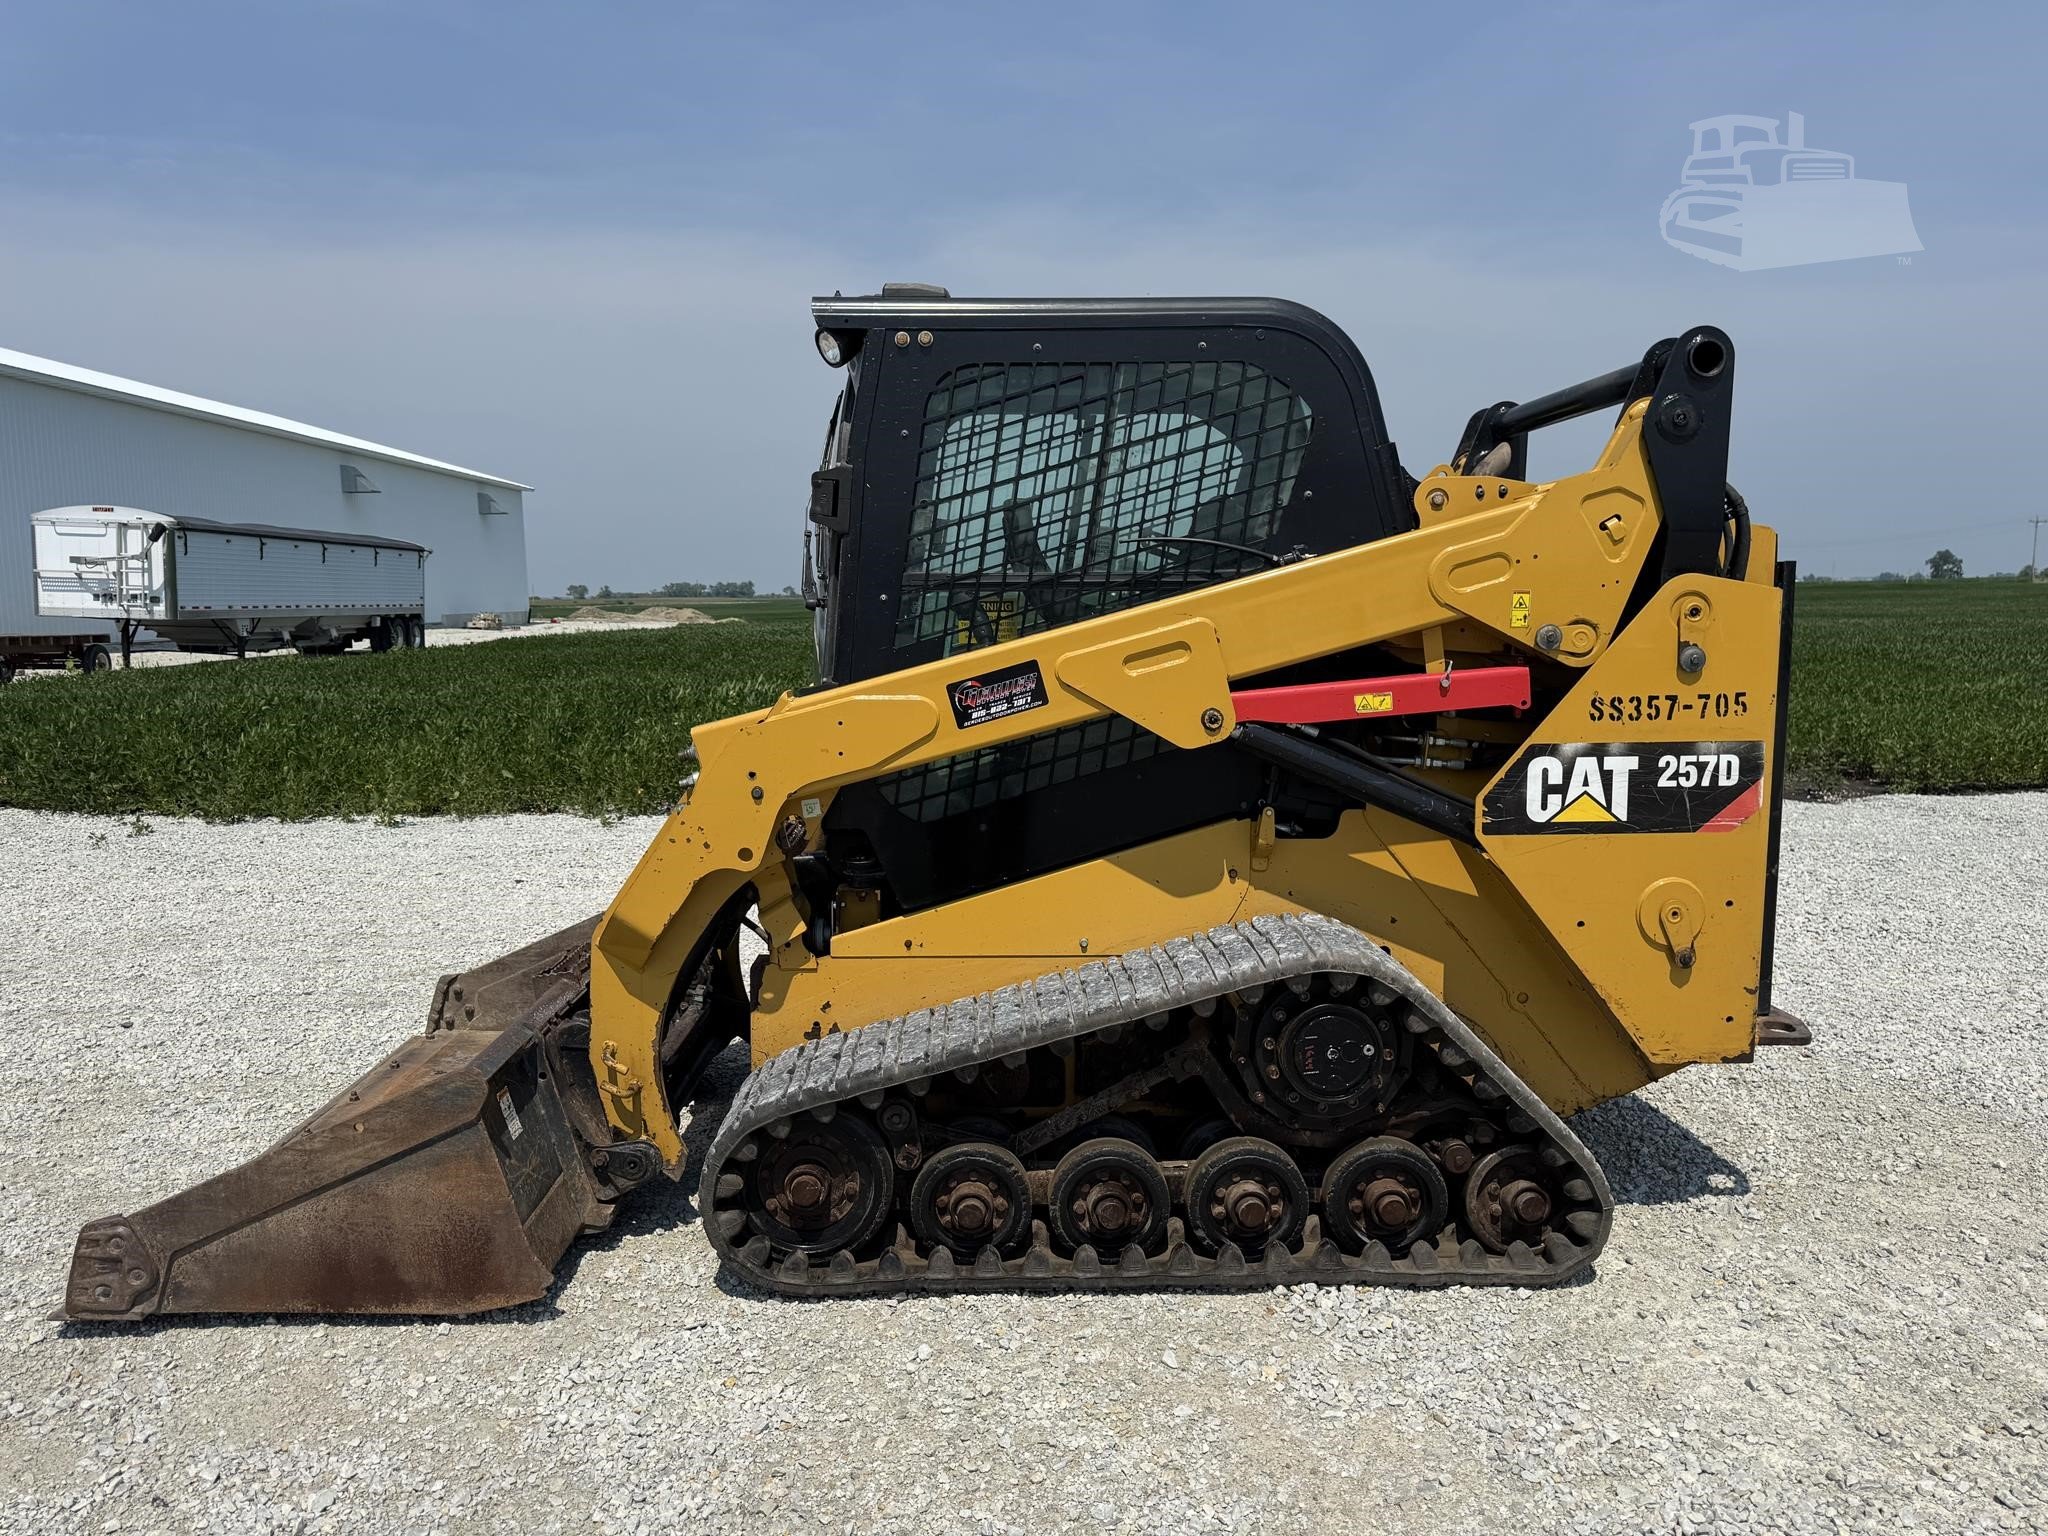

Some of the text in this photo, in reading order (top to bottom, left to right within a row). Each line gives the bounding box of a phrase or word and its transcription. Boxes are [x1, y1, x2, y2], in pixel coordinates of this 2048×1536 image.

[1011, 684, 1036, 696] POWER
[1588, 691, 1748, 722] SS357-705
[1526, 754, 1740, 823] CAT 257D
